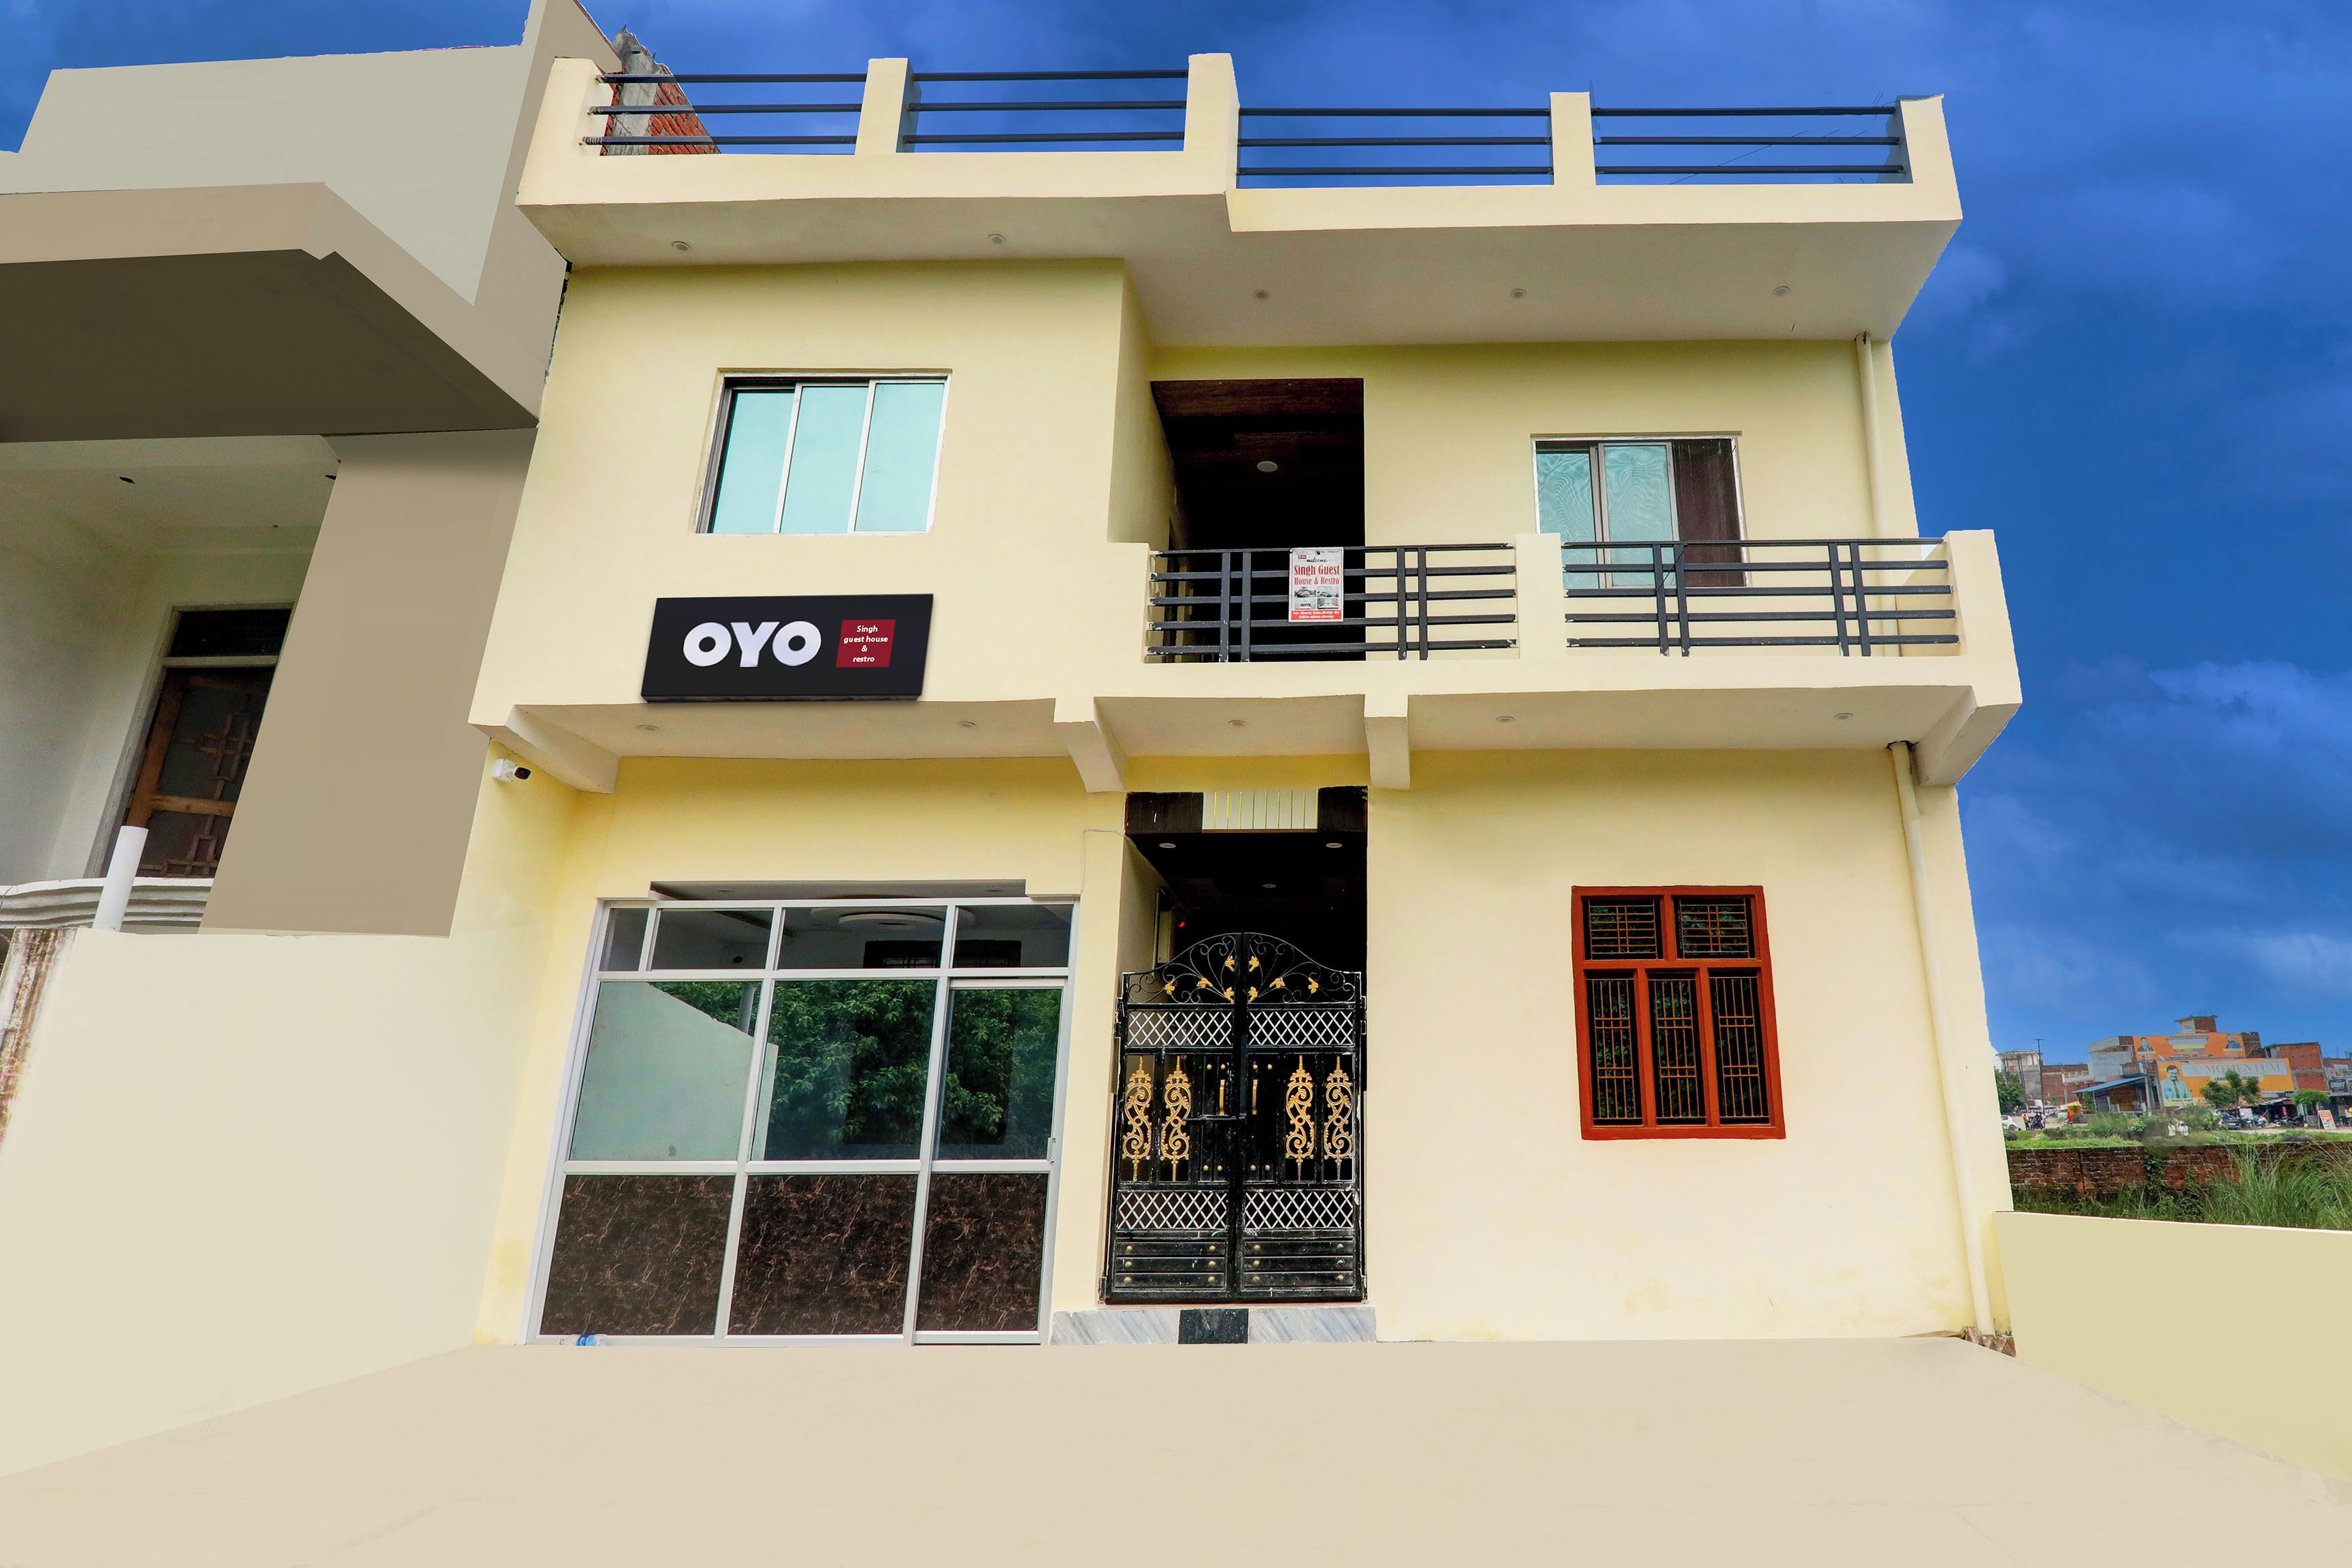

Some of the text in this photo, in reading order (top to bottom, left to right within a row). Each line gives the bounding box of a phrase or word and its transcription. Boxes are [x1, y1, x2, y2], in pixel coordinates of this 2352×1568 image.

[1294, 564, 1340, 577] Singh Guest
[1294, 576, 1340, 585] House & Restro
[856, 625, 878, 634] Singh
[683, 621, 821, 668] OYO
[843, 636, 865, 644] guest
